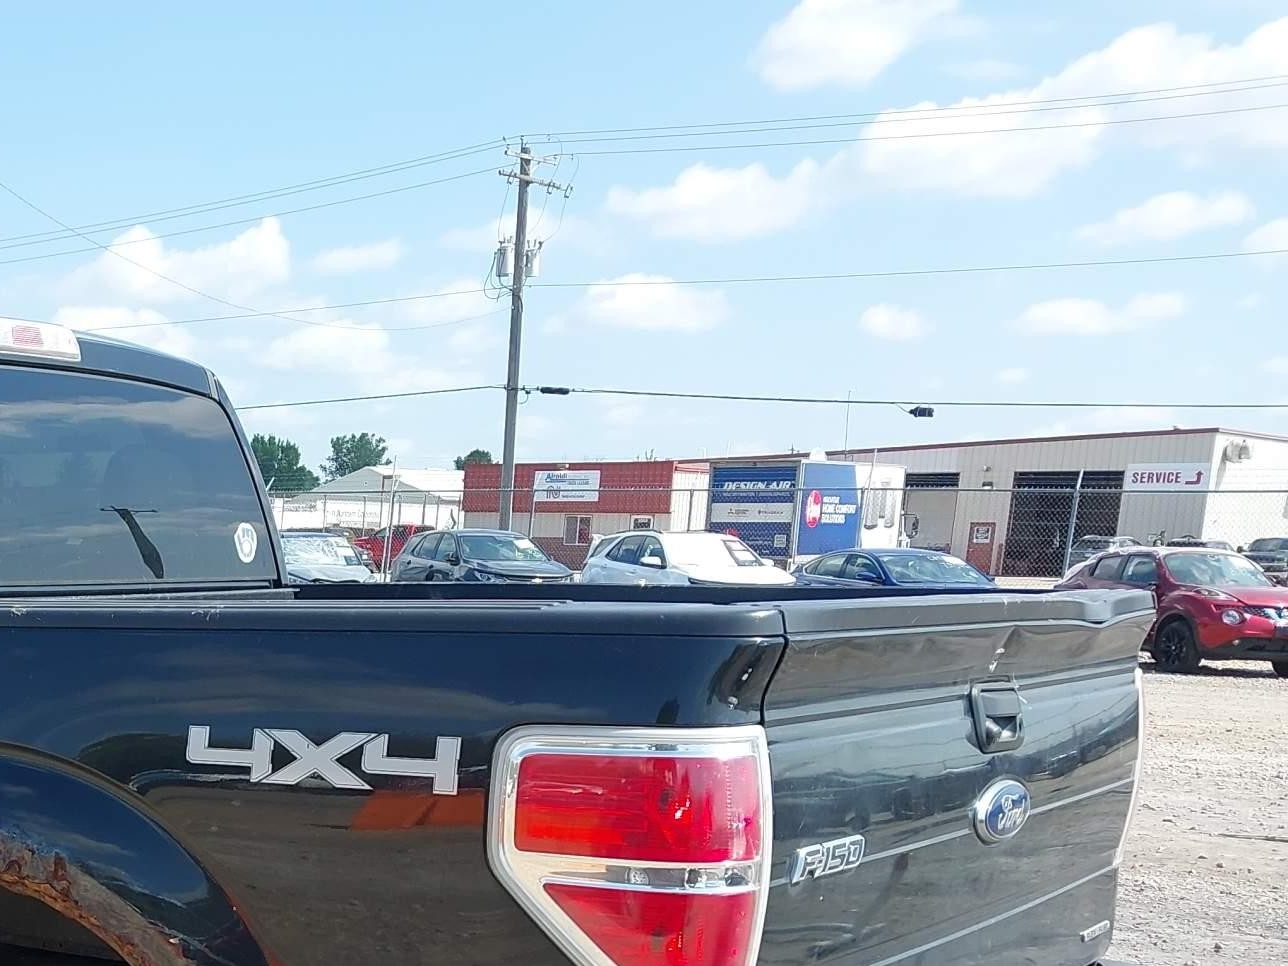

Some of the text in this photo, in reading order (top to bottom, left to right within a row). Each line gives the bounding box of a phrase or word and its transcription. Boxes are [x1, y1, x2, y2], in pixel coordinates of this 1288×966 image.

[1132, 471, 1182, 484] SERVICE
[723, 480, 792, 490] DESIGN AIR
[997, 794, 1026, 831] Ford
